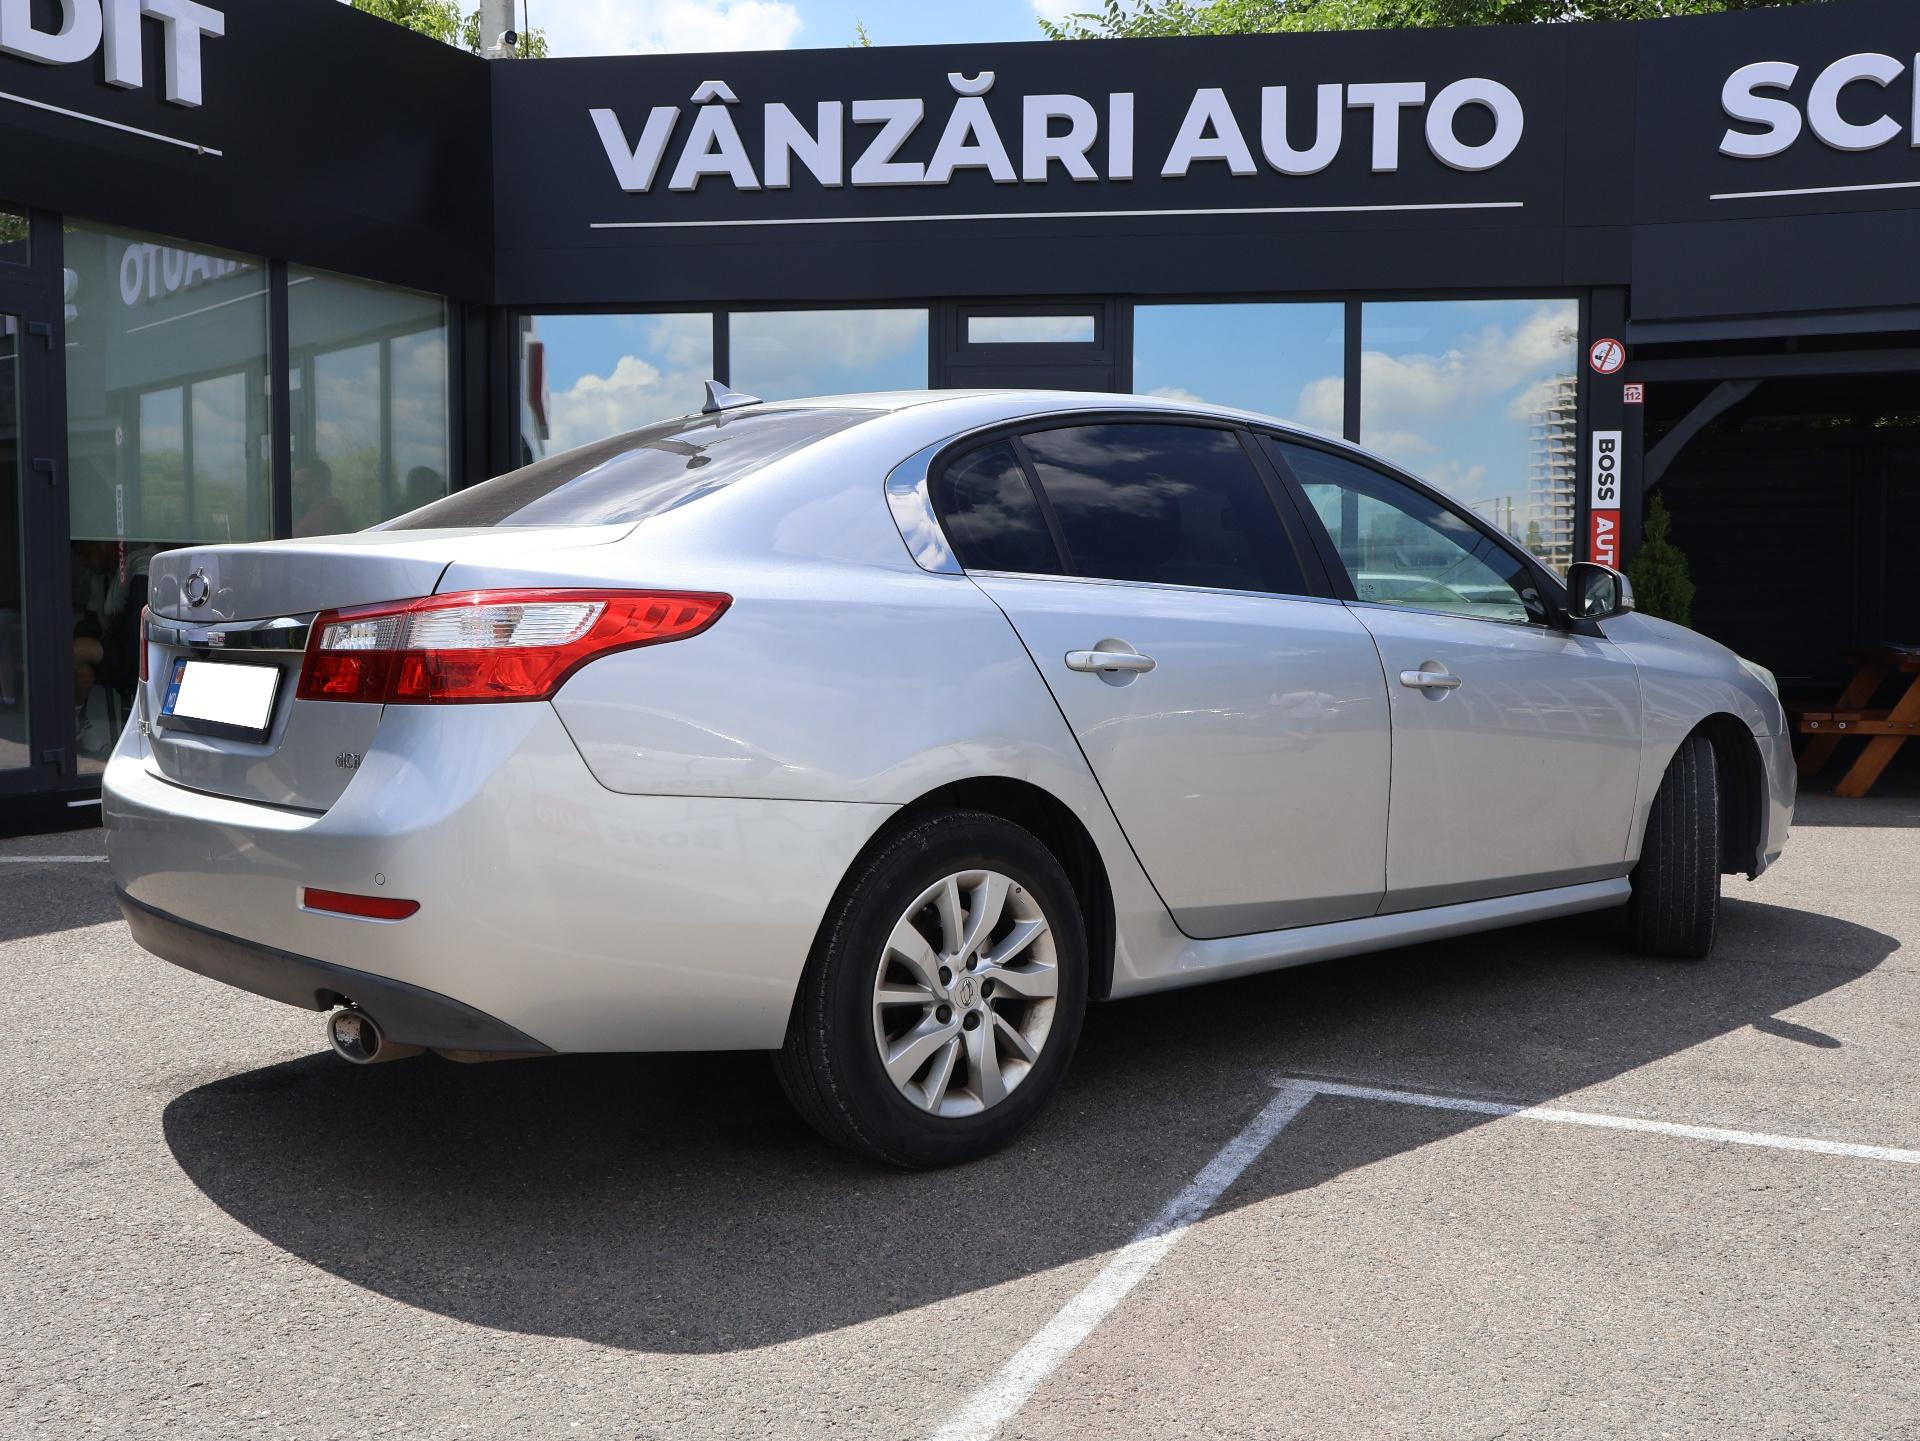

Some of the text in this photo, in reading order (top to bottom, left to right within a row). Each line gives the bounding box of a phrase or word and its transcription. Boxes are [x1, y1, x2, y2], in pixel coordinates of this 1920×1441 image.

[588, 71, 1524, 193] VÂNZĂRI AUTO
[1624, 391, 1641, 401] 112
[1597, 438, 1616, 501] BOSS
